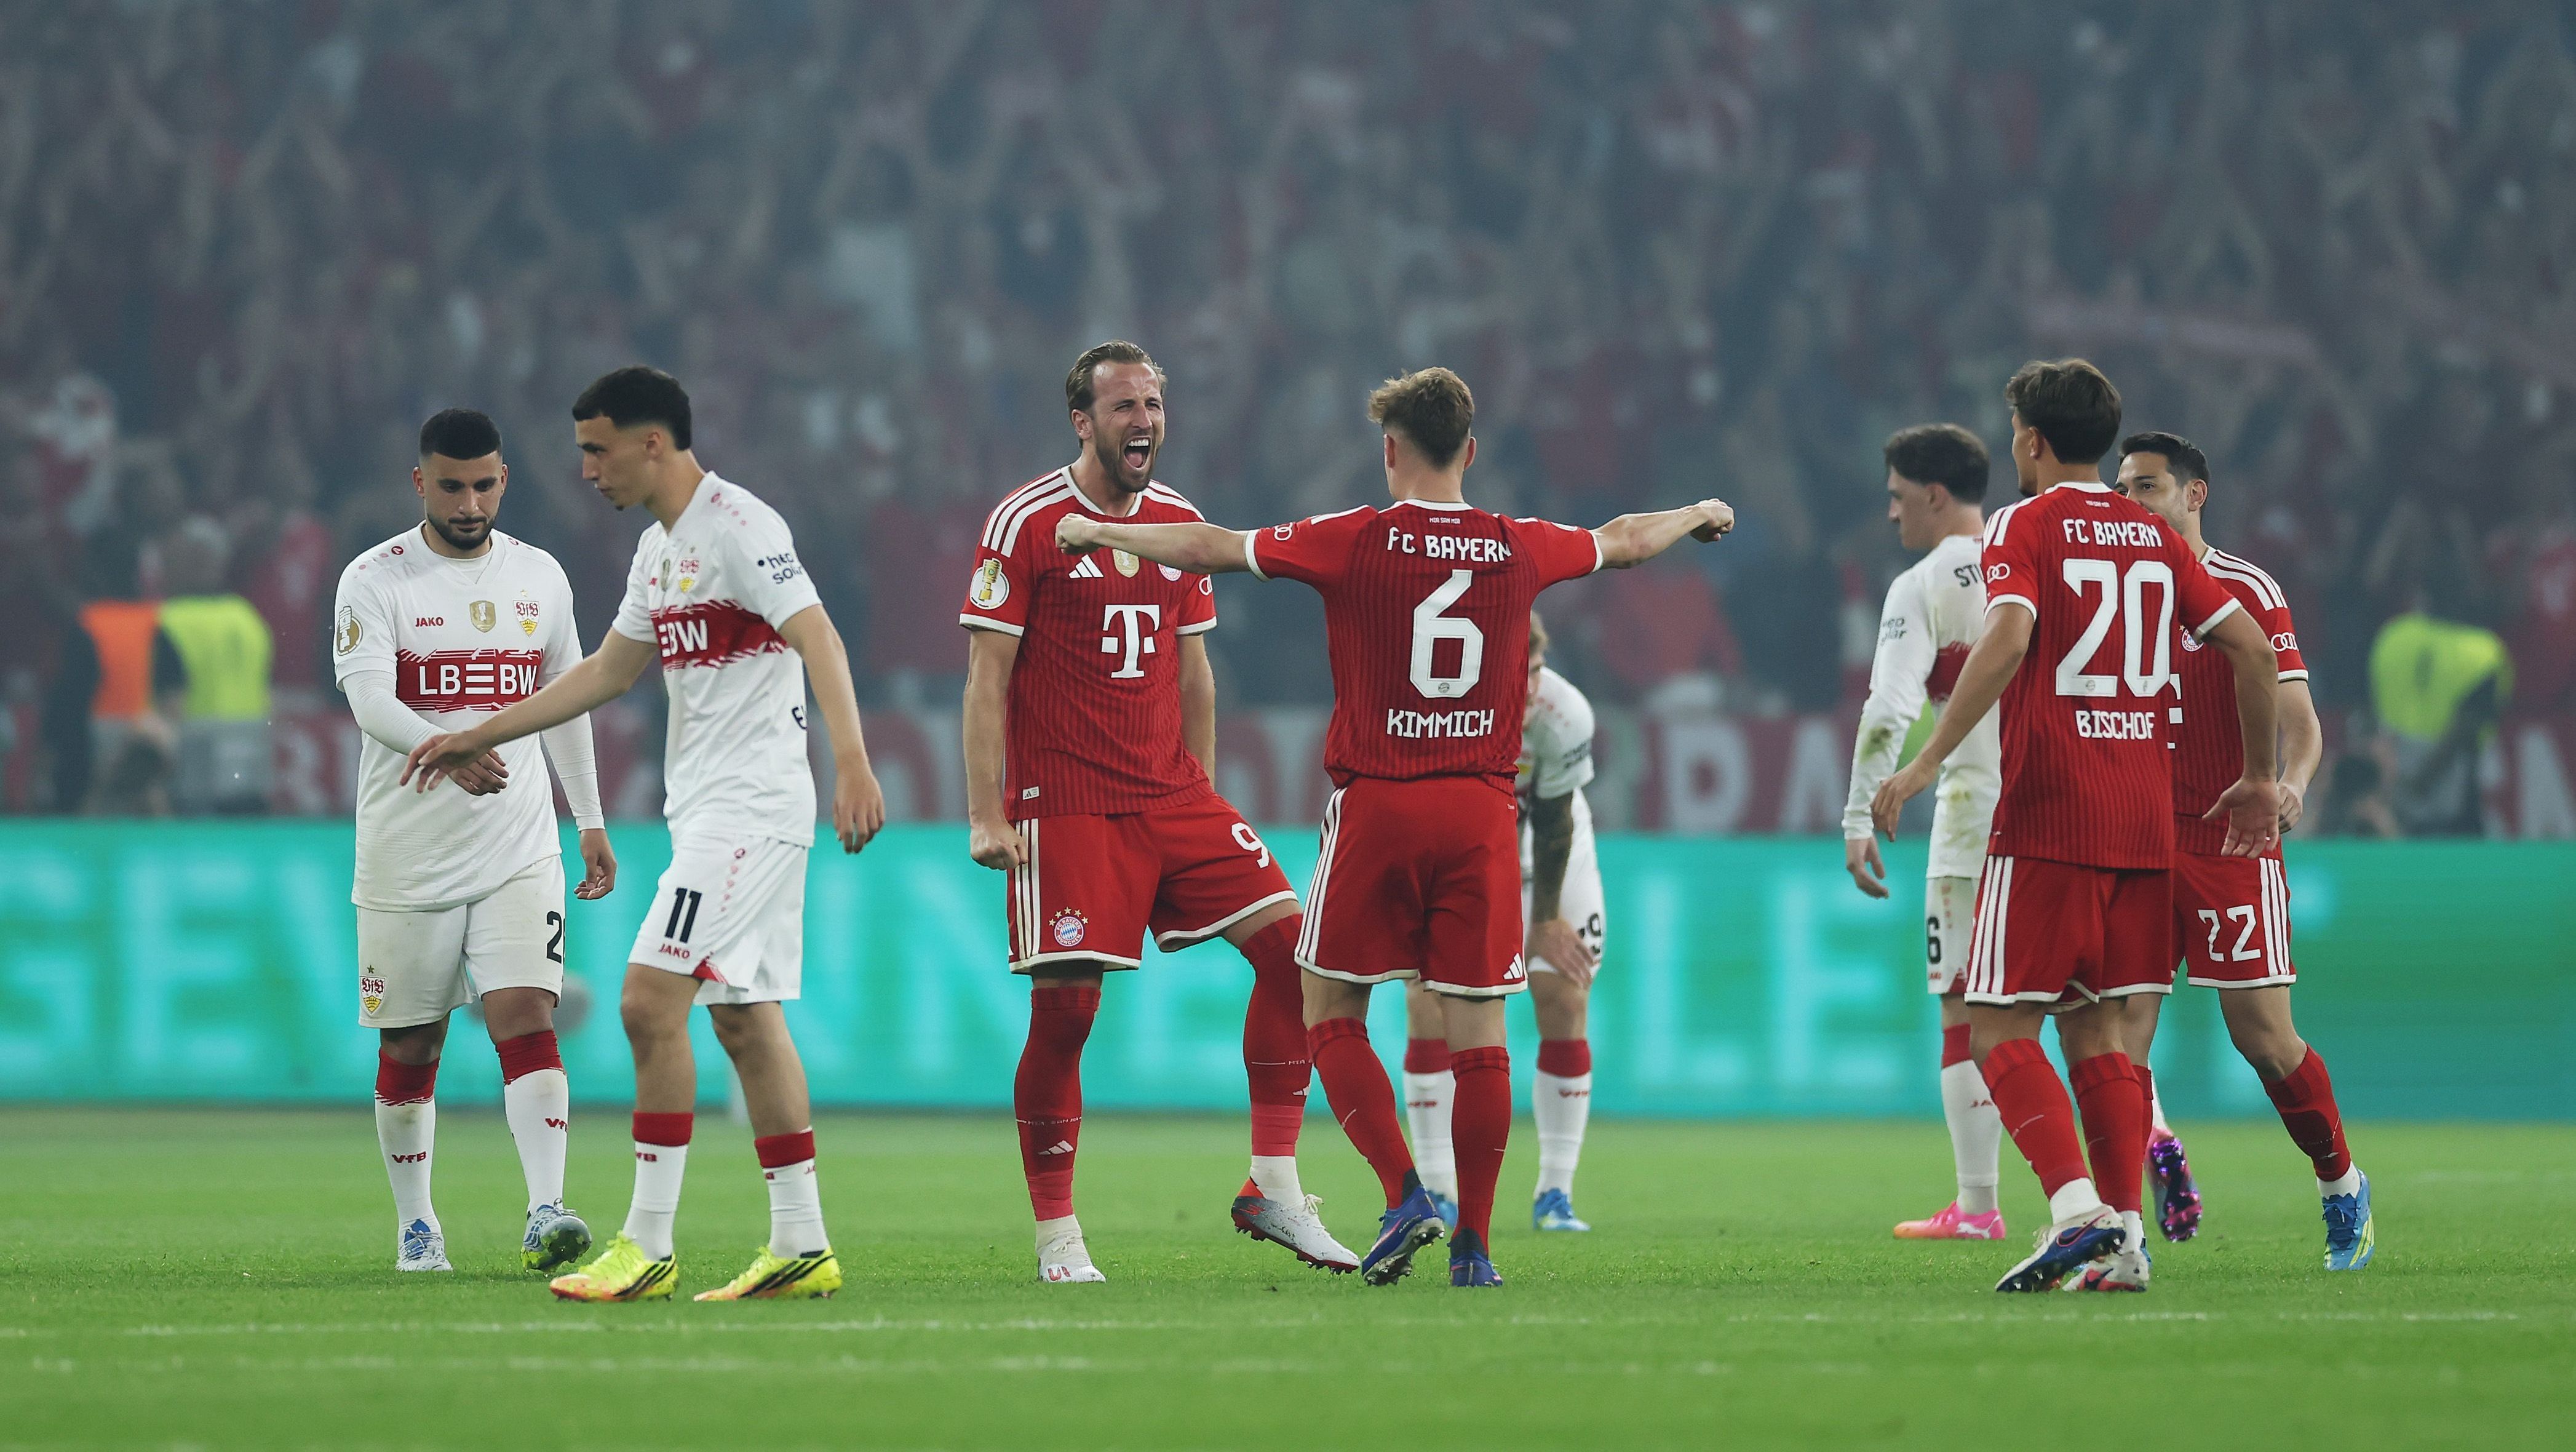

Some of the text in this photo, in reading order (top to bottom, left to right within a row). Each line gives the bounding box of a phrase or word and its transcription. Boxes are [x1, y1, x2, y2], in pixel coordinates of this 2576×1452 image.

[1387, 527, 1512, 562] FC BAYERN
[2062, 519, 2162, 547] FC BAYERN
[415, 617, 443, 627] JAKO
[1102, 604, 1160, 678] T
[1410, 569, 1484, 698] 6
[2056, 558, 2174, 697] 20
[1386, 708, 1494, 738] KIMMICH
[2075, 710, 2155, 740] BISCHOF
[1231, 823, 1270, 869] 9
[547, 911, 565, 964] 2
[664, 887, 702, 944] 11
[2197, 904, 2262, 962] 22
[659, 944, 690, 959] JAKO
[1927, 916, 1941, 964] 6
[392, 1151, 426, 1163] VfB
